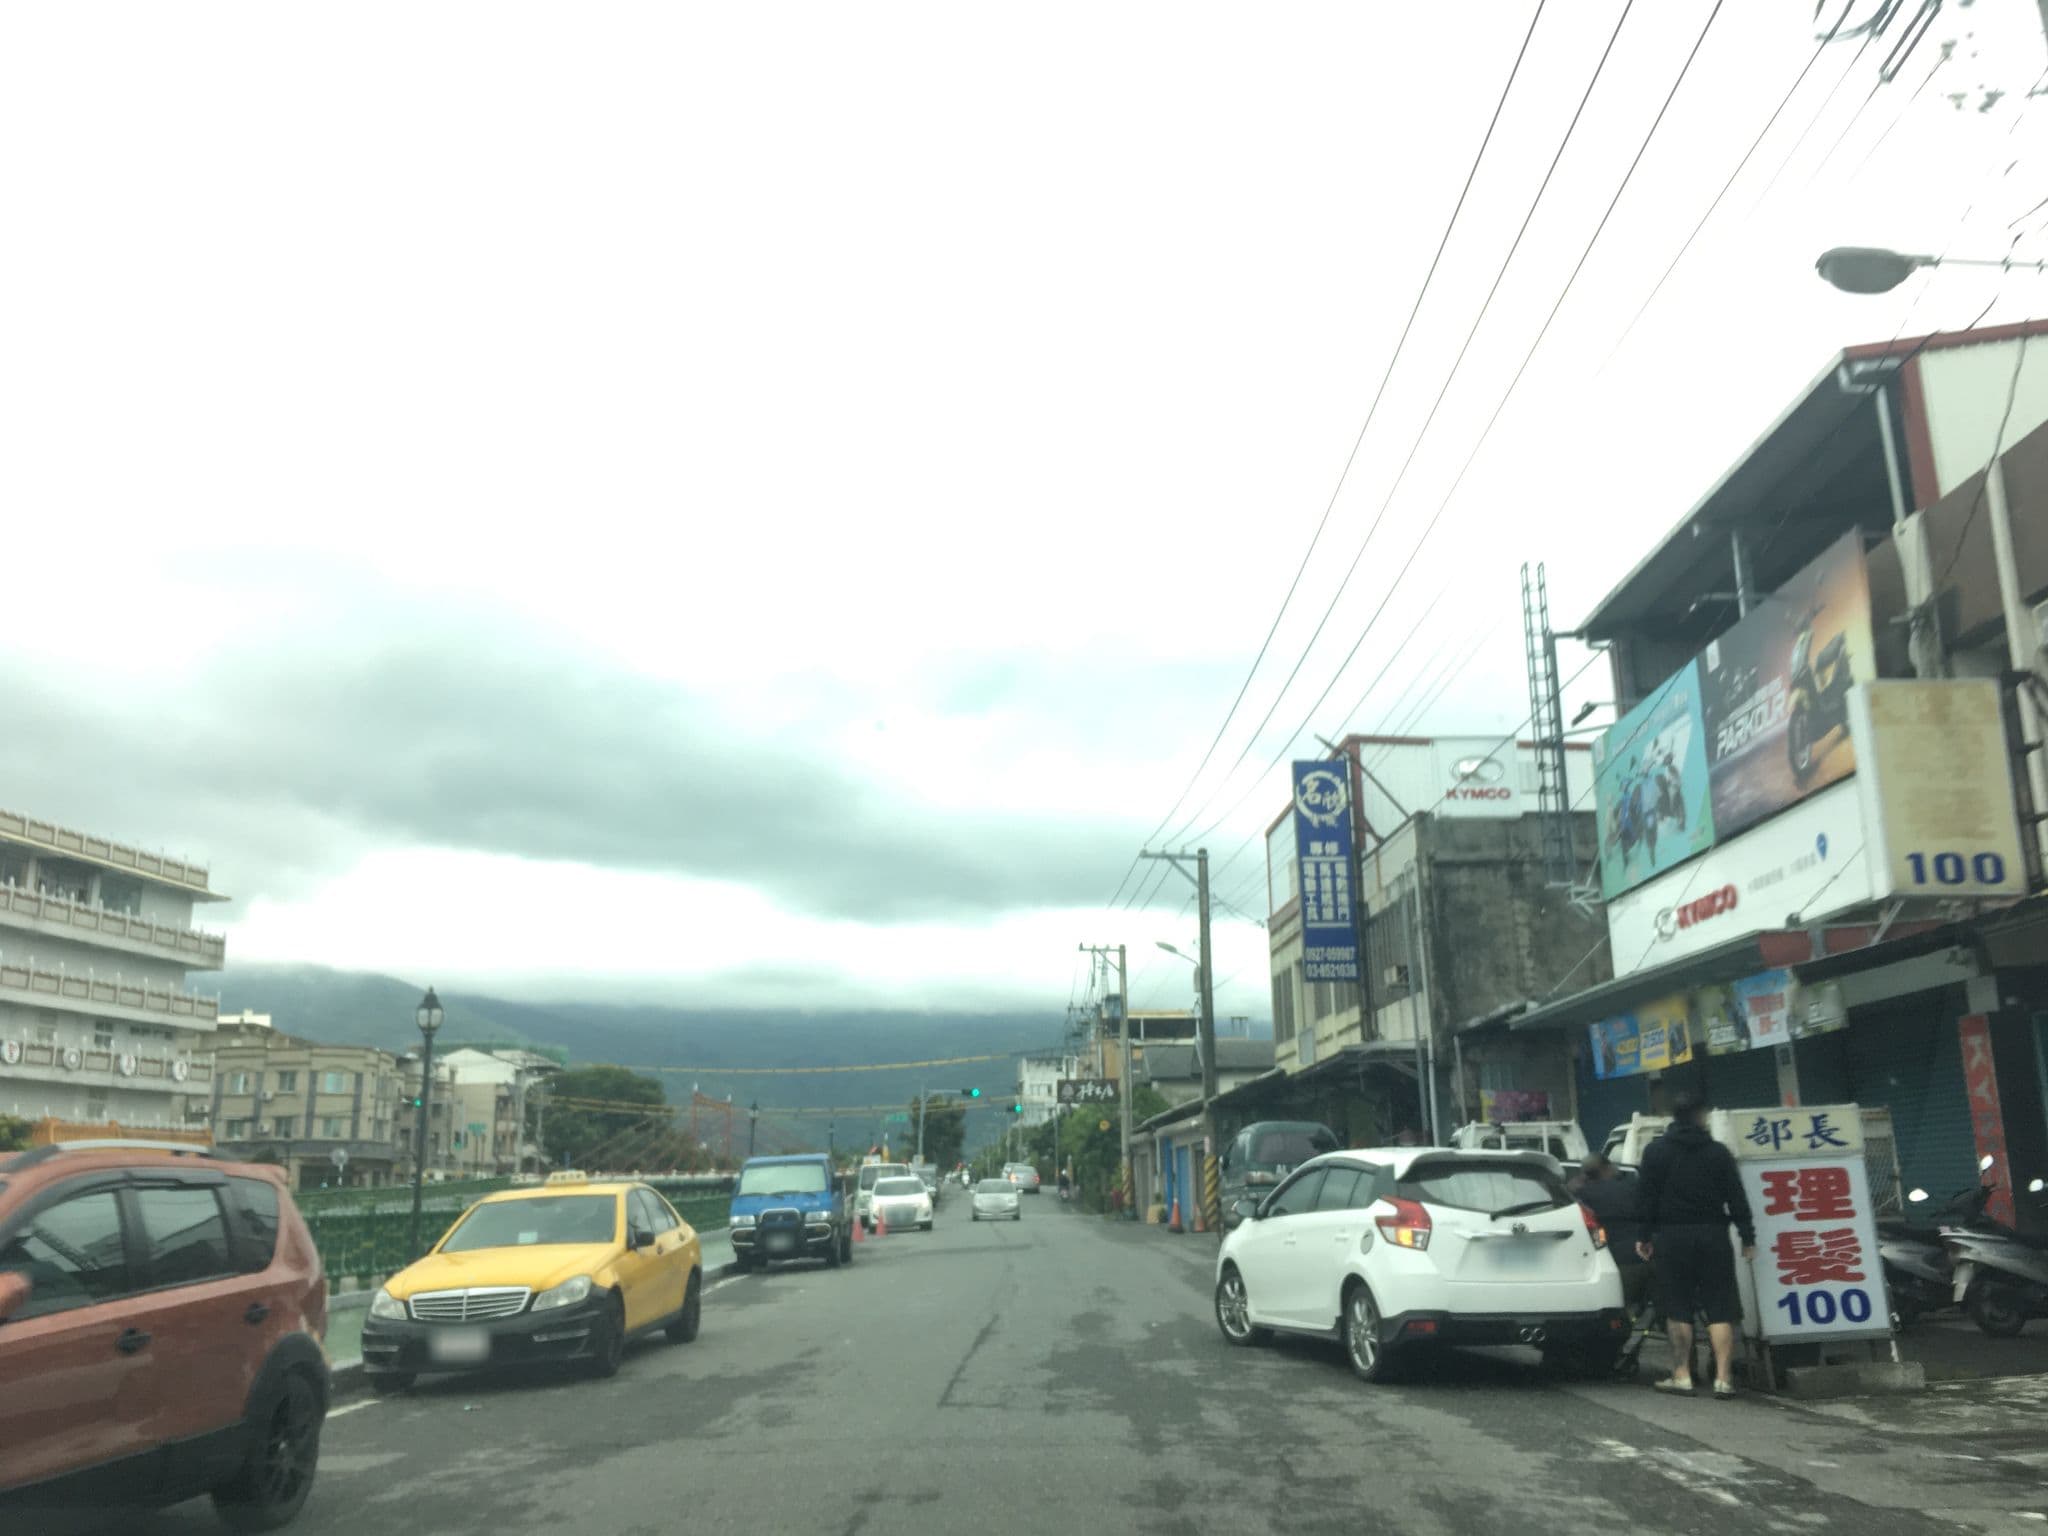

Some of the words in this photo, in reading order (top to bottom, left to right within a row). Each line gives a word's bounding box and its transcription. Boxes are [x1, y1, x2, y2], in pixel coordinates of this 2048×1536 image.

[1716, 687, 1789, 760] PARKOUR
[1446, 787, 1511, 800] KYMCO
[1906, 851, 2005, 885] 100
[1677, 883, 1738, 929] KYMCO
[1746, 1113, 1849, 1150] 部長
[1761, 1167, 1866, 1285] 理髮
[1778, 1288, 1872, 1326] 100
